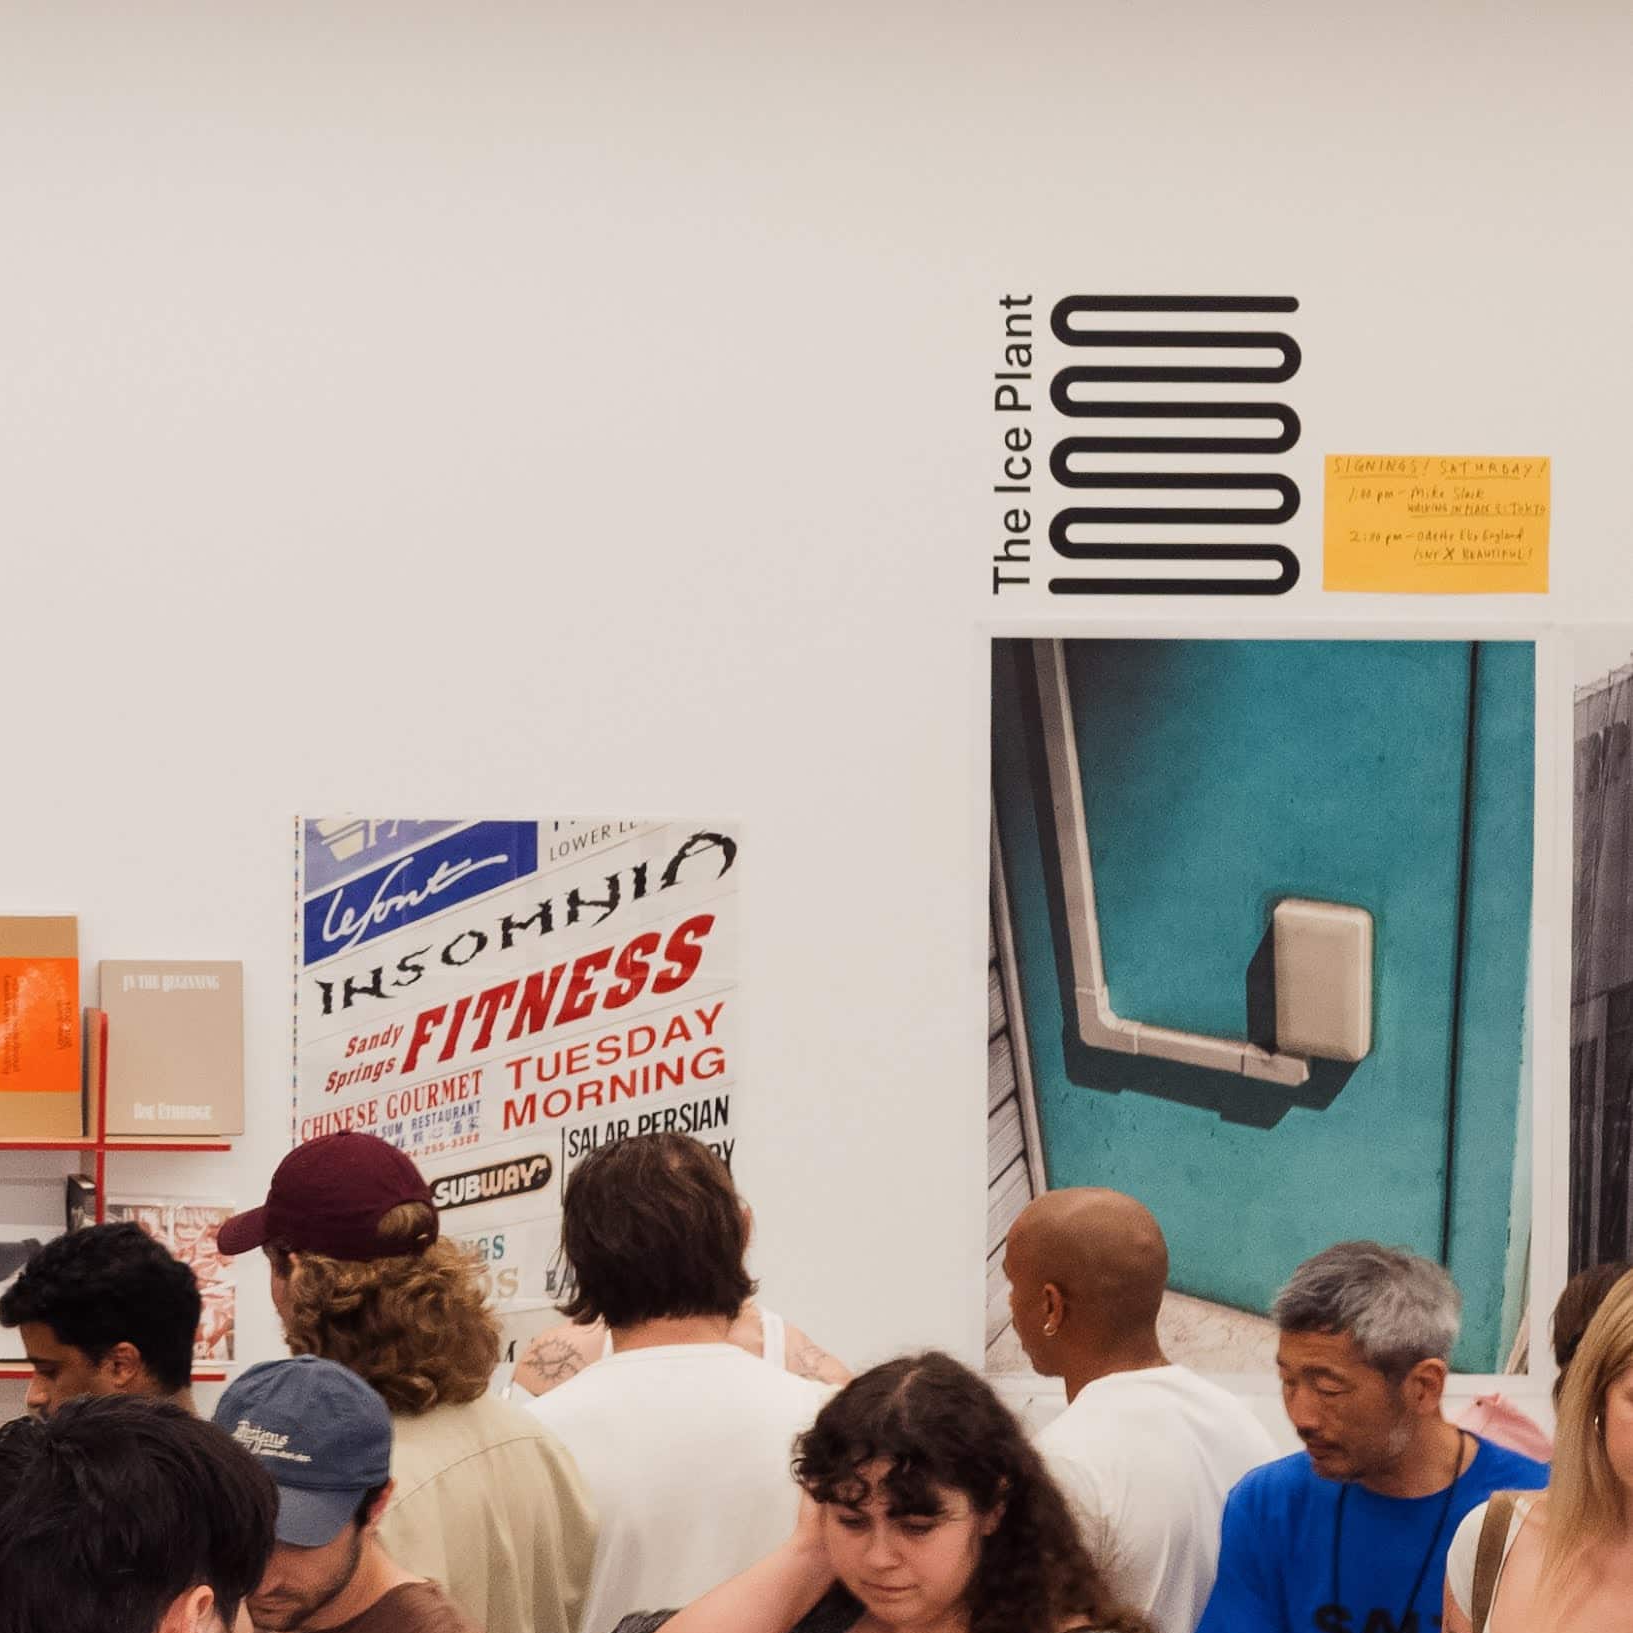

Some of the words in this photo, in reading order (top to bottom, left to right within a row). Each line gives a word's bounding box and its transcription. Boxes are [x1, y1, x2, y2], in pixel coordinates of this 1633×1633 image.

[994, 294, 1032, 413] Plant
[994, 426, 1032, 493] Ice
[992, 508, 1032, 594] The
[550, 823, 611, 862] LOWER
[313, 829, 738, 1018] INSOMNIA
[399, 914, 716, 1075] FITNESS
[325, 1054, 396, 1094] Springs
[344, 1021, 404, 1059] Sandy
[506, 1001, 725, 1091] TUESDAY
[301, 1100, 378, 1143] CHINESE
[386, 1069, 483, 1120] GOURMET
[411, 1100, 481, 1129] RESTAURANT
[502, 1046, 727, 1132] MORNING
[637, 1094, 730, 1136] PERSIAN
[434, 1157, 547, 1208] SUBWAY
